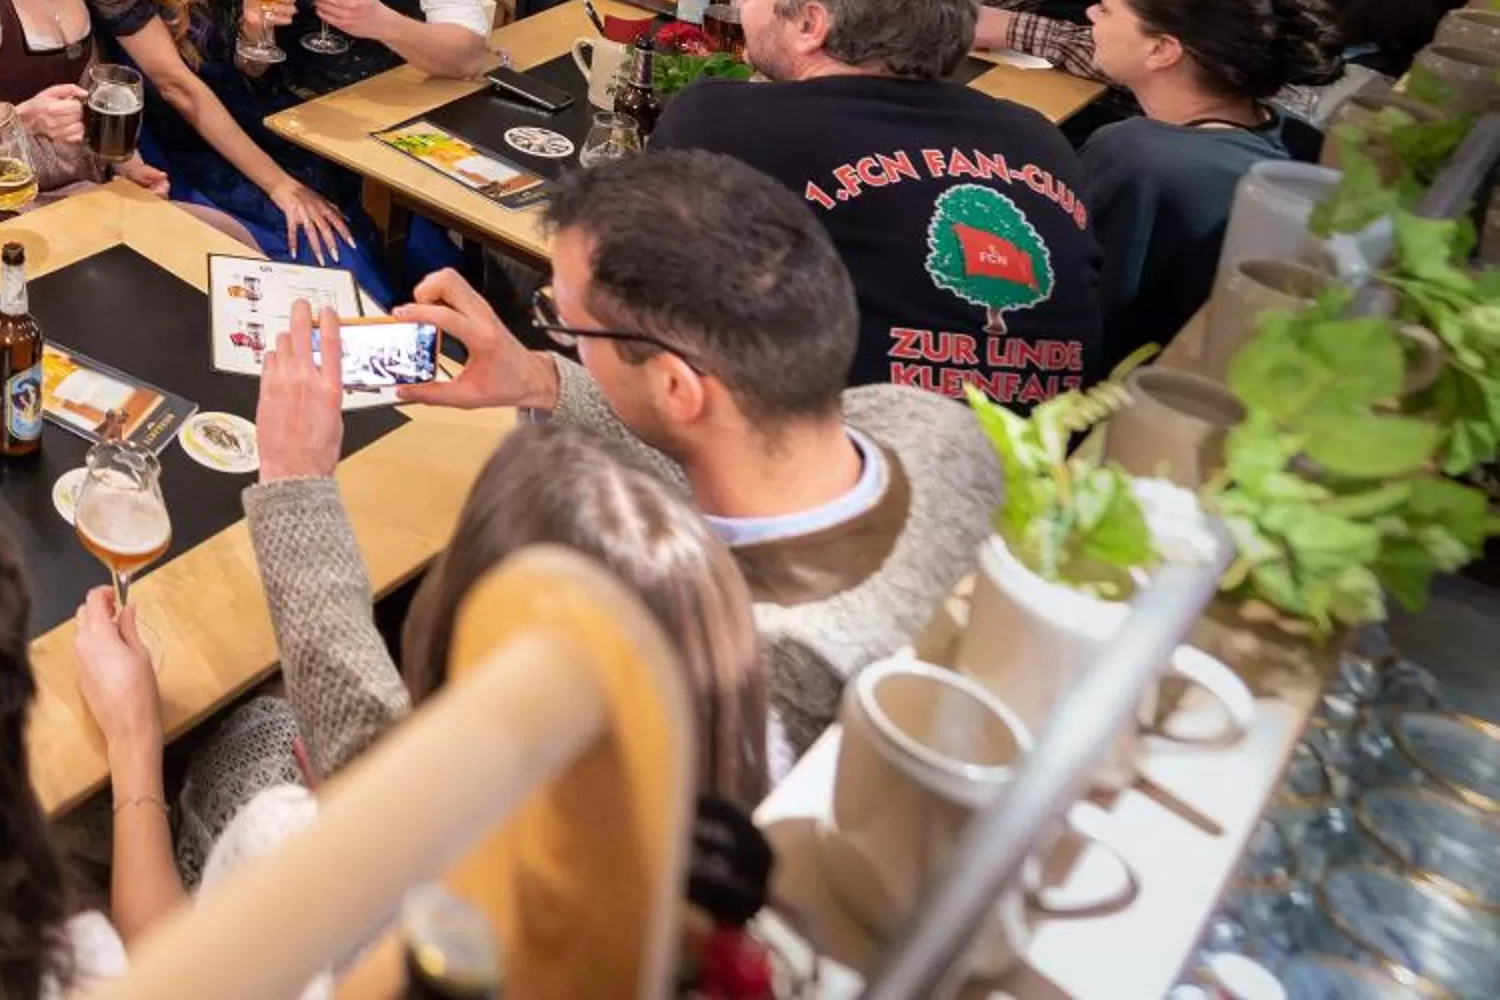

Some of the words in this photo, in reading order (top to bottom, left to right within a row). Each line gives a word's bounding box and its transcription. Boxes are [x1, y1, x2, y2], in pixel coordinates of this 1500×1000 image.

[804, 150, 922, 211] 1.FCN
[887, 327, 980, 365] ZUR
[986, 335, 1083, 371] LINDE
